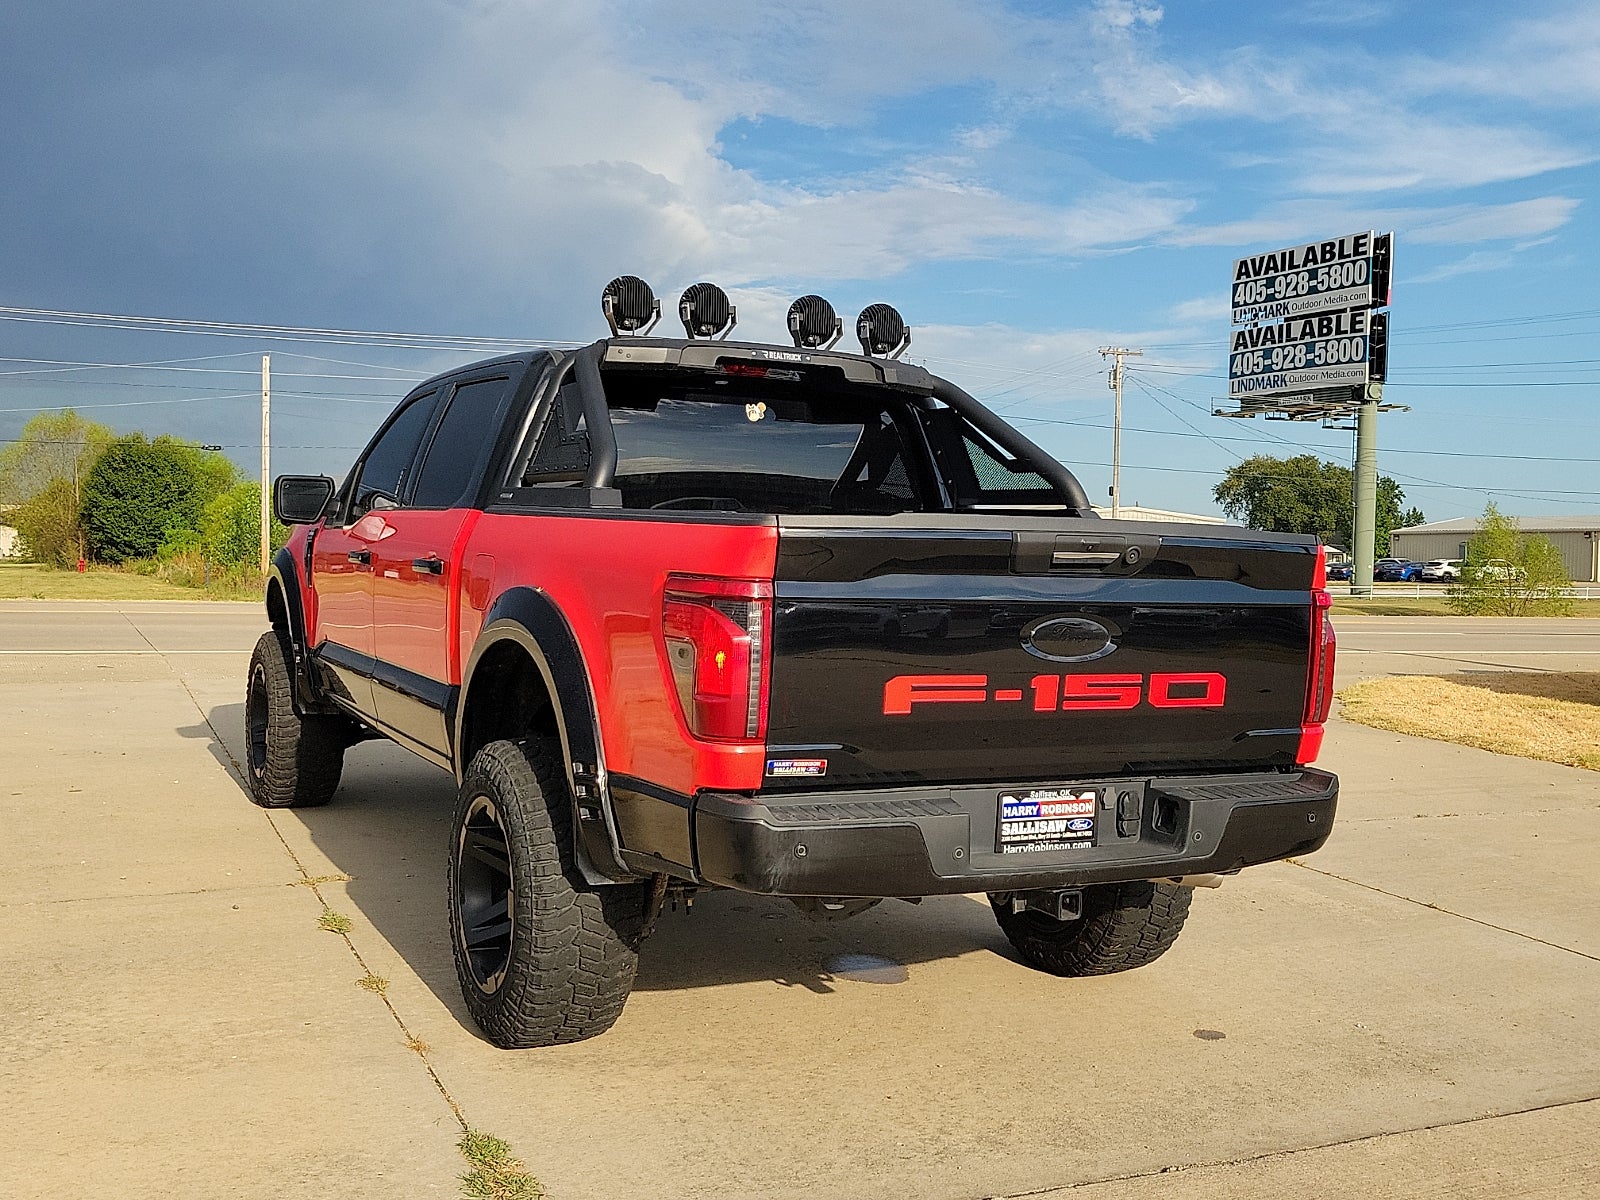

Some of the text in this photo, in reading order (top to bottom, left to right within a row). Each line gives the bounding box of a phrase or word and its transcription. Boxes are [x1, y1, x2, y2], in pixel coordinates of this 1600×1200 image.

[1236, 233, 1369, 281] AVAILABLE
[1235, 260, 1367, 306] 405-928-5800
[1291, 300, 1322, 312] Outdoor
[1323, 290, 1367, 305] Media.com
[1233, 311, 1365, 352] AVAILABLE
[1232, 337, 1364, 377] 405-928-5800
[1288, 373, 1319, 384] Outdoor
[1320, 368, 1364, 380] Media.com
[883, 673, 1226, 715] F-150
[1059, 789, 1071, 797] OK
[1003, 803, 1093, 818] HARRY ROBINSON
[1002, 820, 1068, 836] SALLISAW
